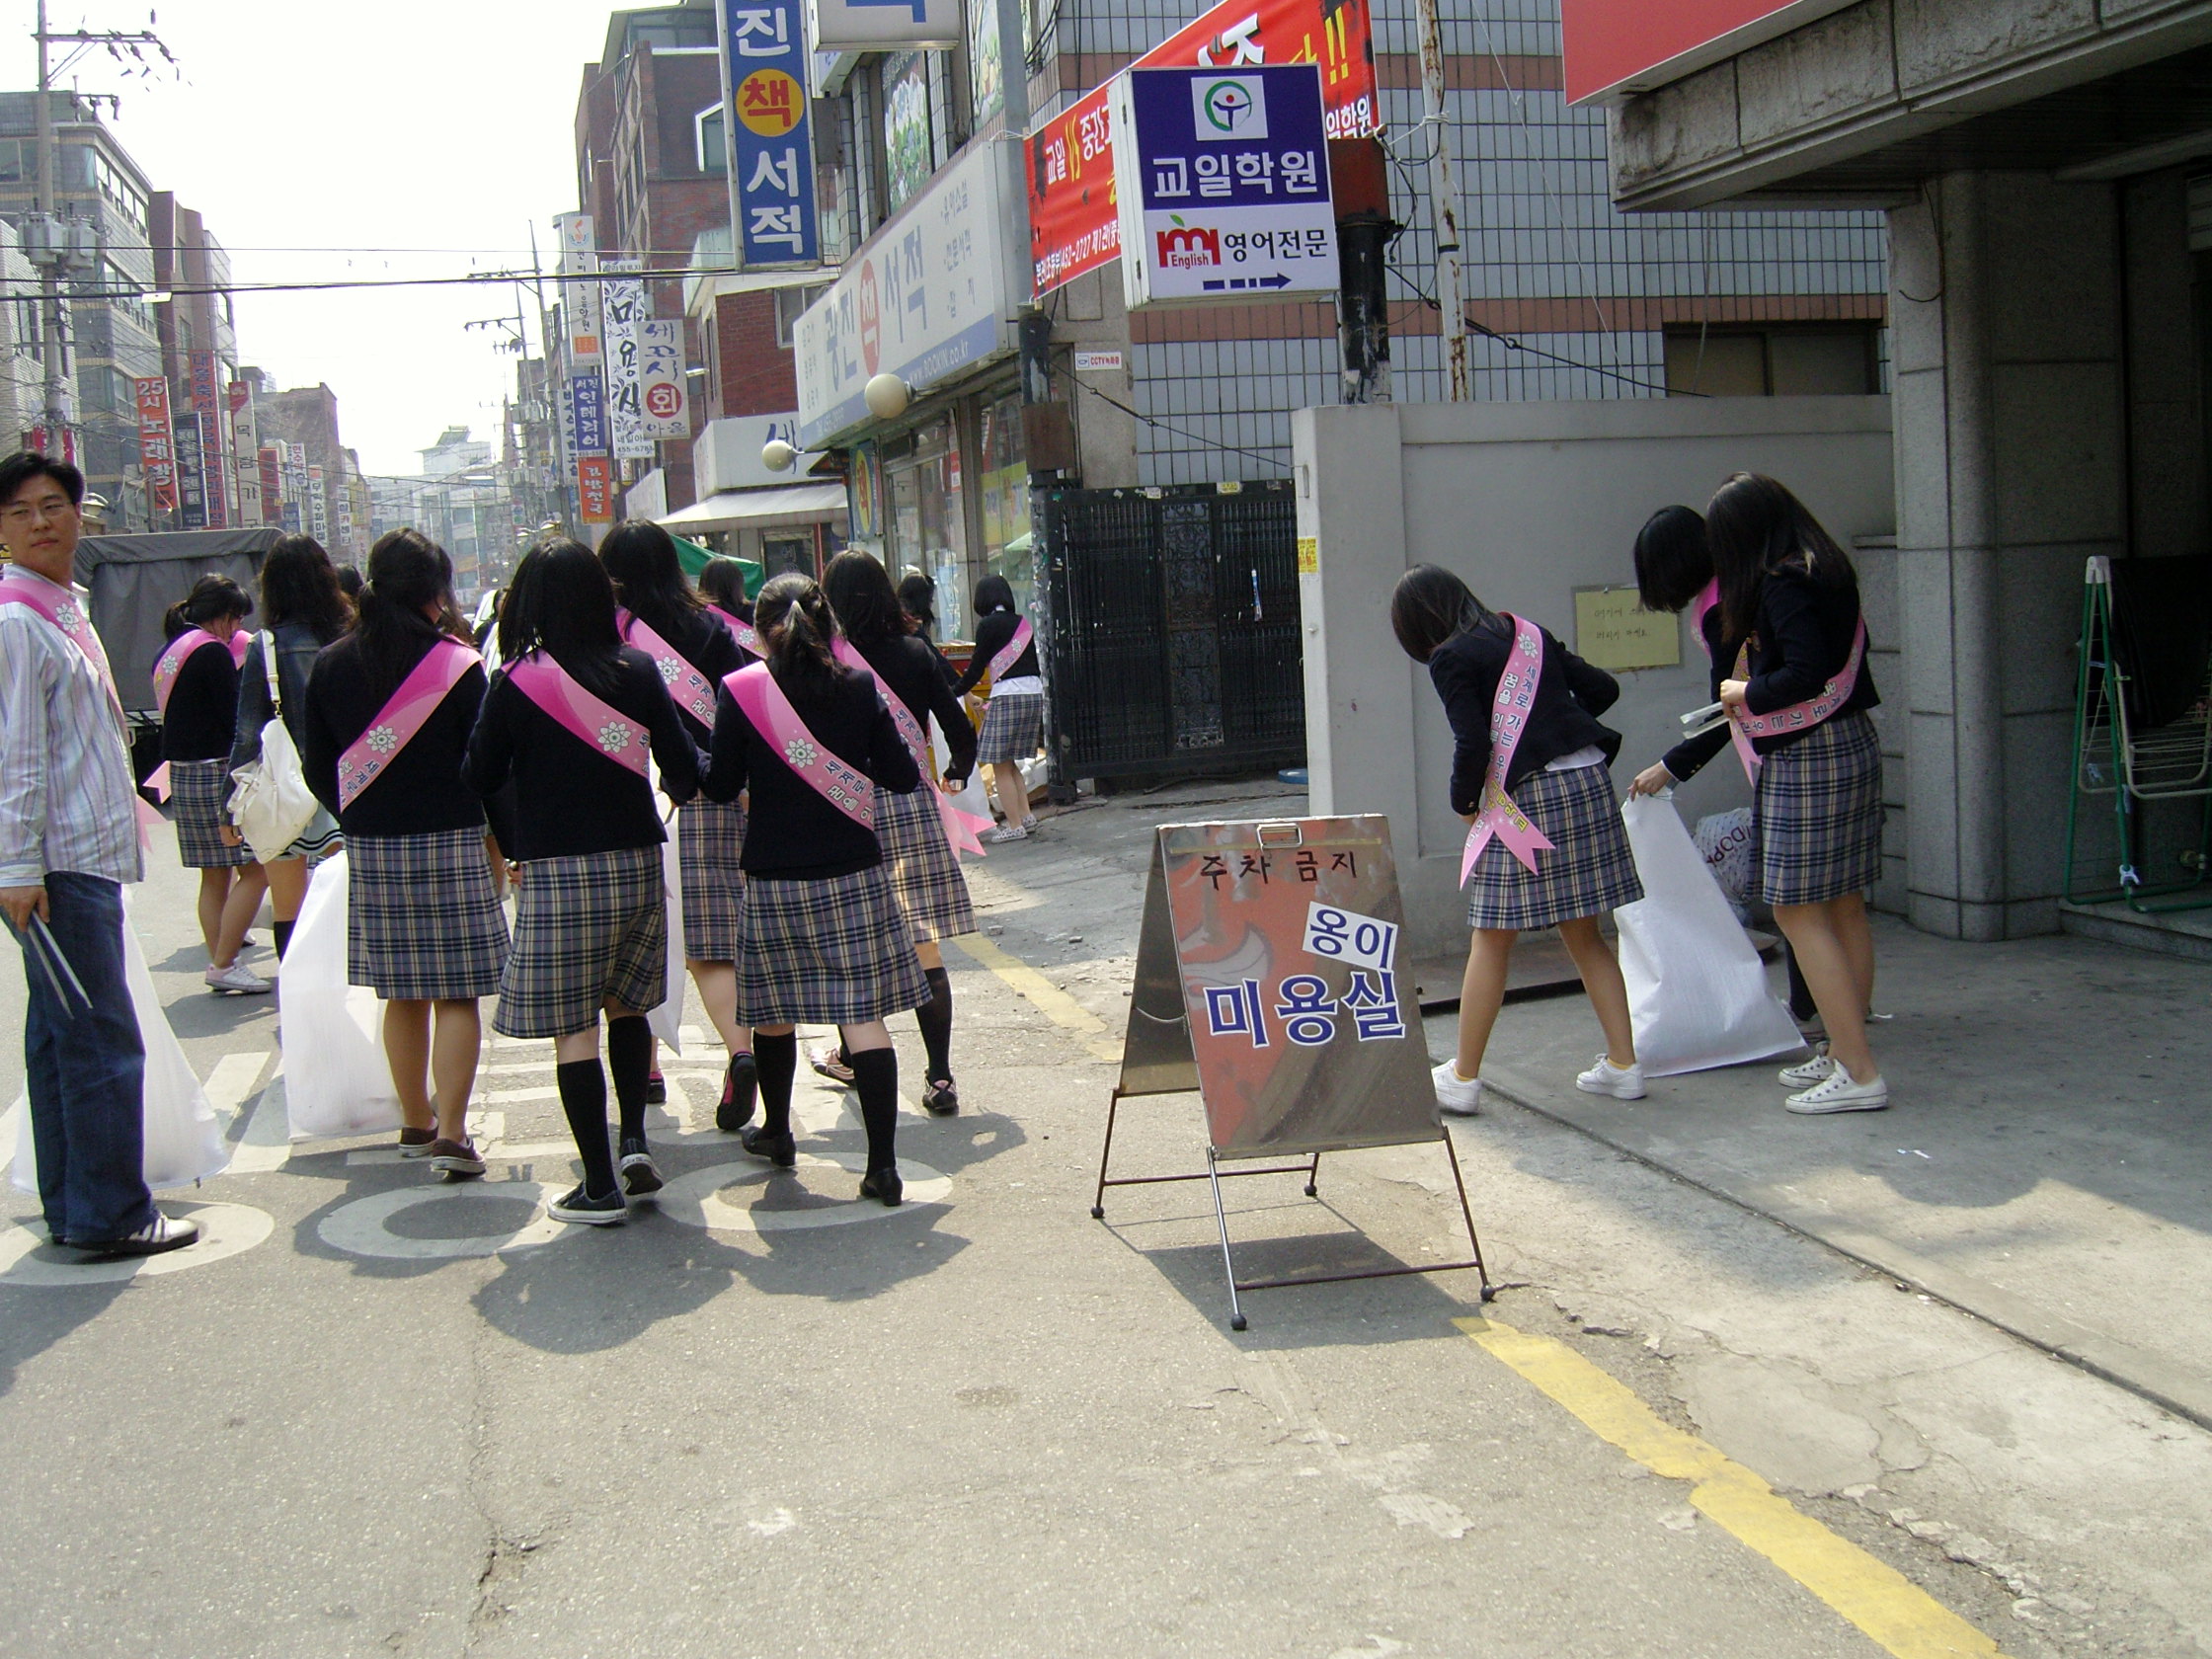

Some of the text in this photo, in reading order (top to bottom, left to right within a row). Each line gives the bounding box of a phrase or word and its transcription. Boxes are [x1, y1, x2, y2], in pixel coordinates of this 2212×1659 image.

[744, 78, 791, 127] 책
[1046, 137, 1066, 185] 교일
[1152, 150, 1318, 198] 교일학원
[746, 148, 803, 255] 서적
[1171, 229, 1328, 270] English 영어전문
[885, 225, 926, 344] 서적
[610, 291, 641, 416] 미용실
[645, 323, 680, 381] 세꼬시
[137, 381, 164, 408] 25시
[653, 388, 677, 414] 회
[579, 391, 598, 447] 인테리어
[142, 415, 173, 487] 노래방
[585, 466, 604, 514] 김밥천국
[1498, 672, 1519, 705] 꿈을
[1515, 665, 1538, 708] 세계로
[1501, 714, 1522, 748] 가는
[348, 760, 380, 793] 세계로
[824, 760, 867, 795] 세계로
[827, 785, 859, 811] 꿈을
[1200, 850, 1358, 891] 주차 금지
[1308, 908, 1395, 970] 옹이
[1202, 970, 1406, 1049] 미용실
